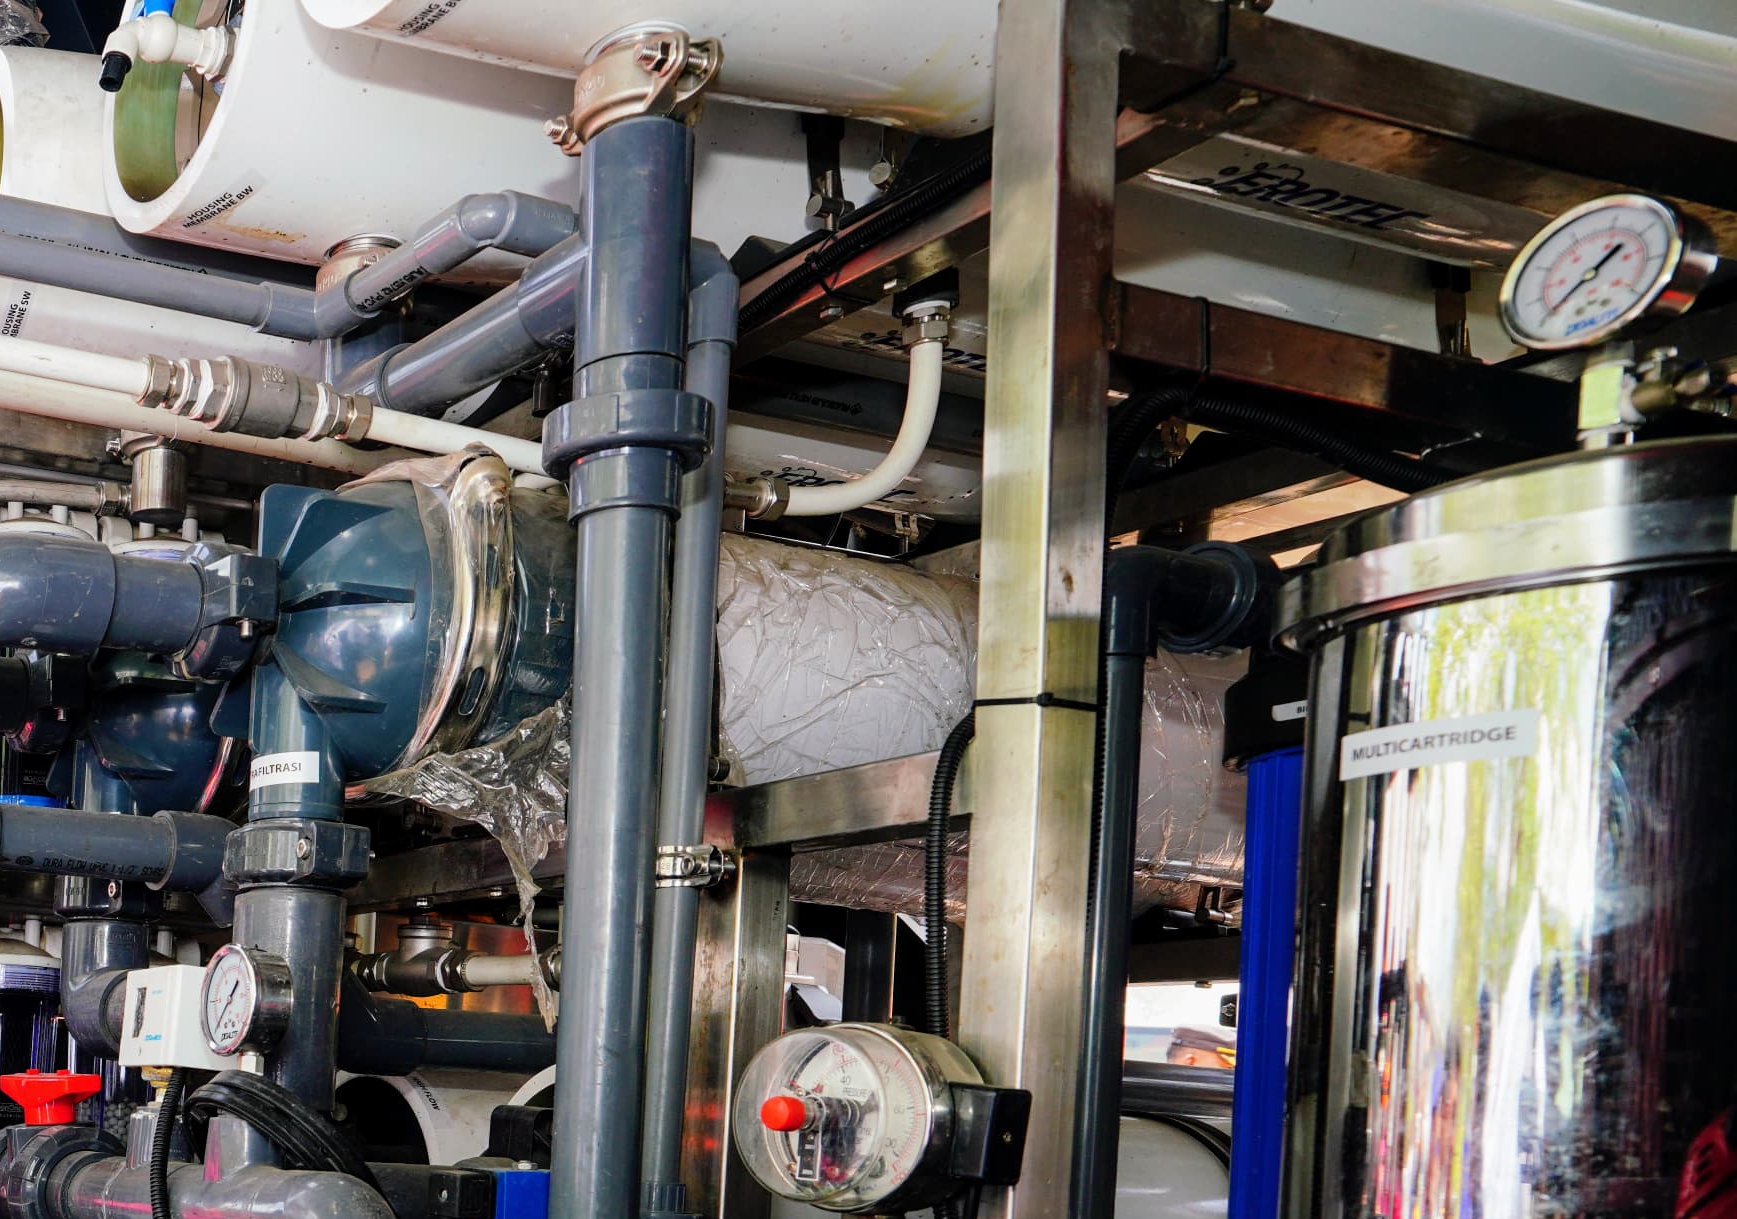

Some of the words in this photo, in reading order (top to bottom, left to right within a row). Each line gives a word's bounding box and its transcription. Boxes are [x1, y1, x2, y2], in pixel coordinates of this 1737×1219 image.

[182, 199, 237, 228] MEMBRANE
[236, 186, 253, 200] BW
[187, 192, 233, 220] HOUSING
[21, 291, 31, 306] SW
[1, 303, 18, 335] OUSING
[1352, 725, 1517, 761] MULTICARTRIDGE
[66, 859, 87, 870] FLOW
